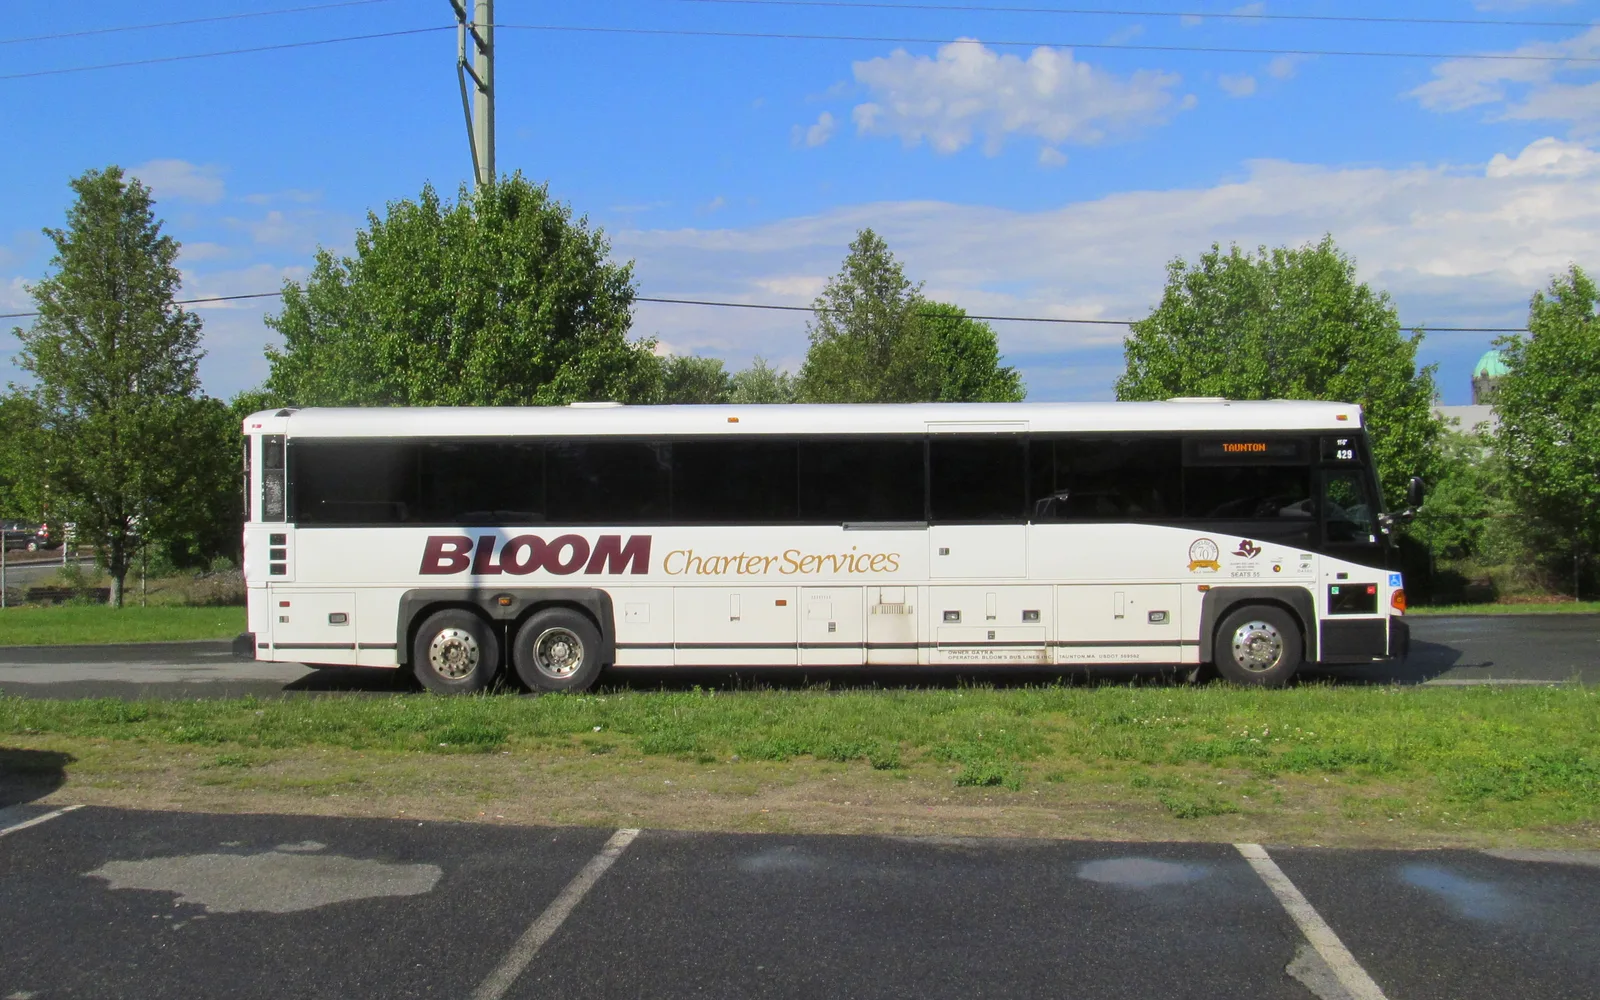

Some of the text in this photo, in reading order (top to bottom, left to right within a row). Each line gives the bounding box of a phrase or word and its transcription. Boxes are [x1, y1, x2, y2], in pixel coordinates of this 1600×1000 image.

[1222, 443, 1266, 453] TAUNTON
[1336, 449, 1353, 459] 429
[418, 534, 653, 575] BLOOM
[663, 546, 900, 575] Charter Services
